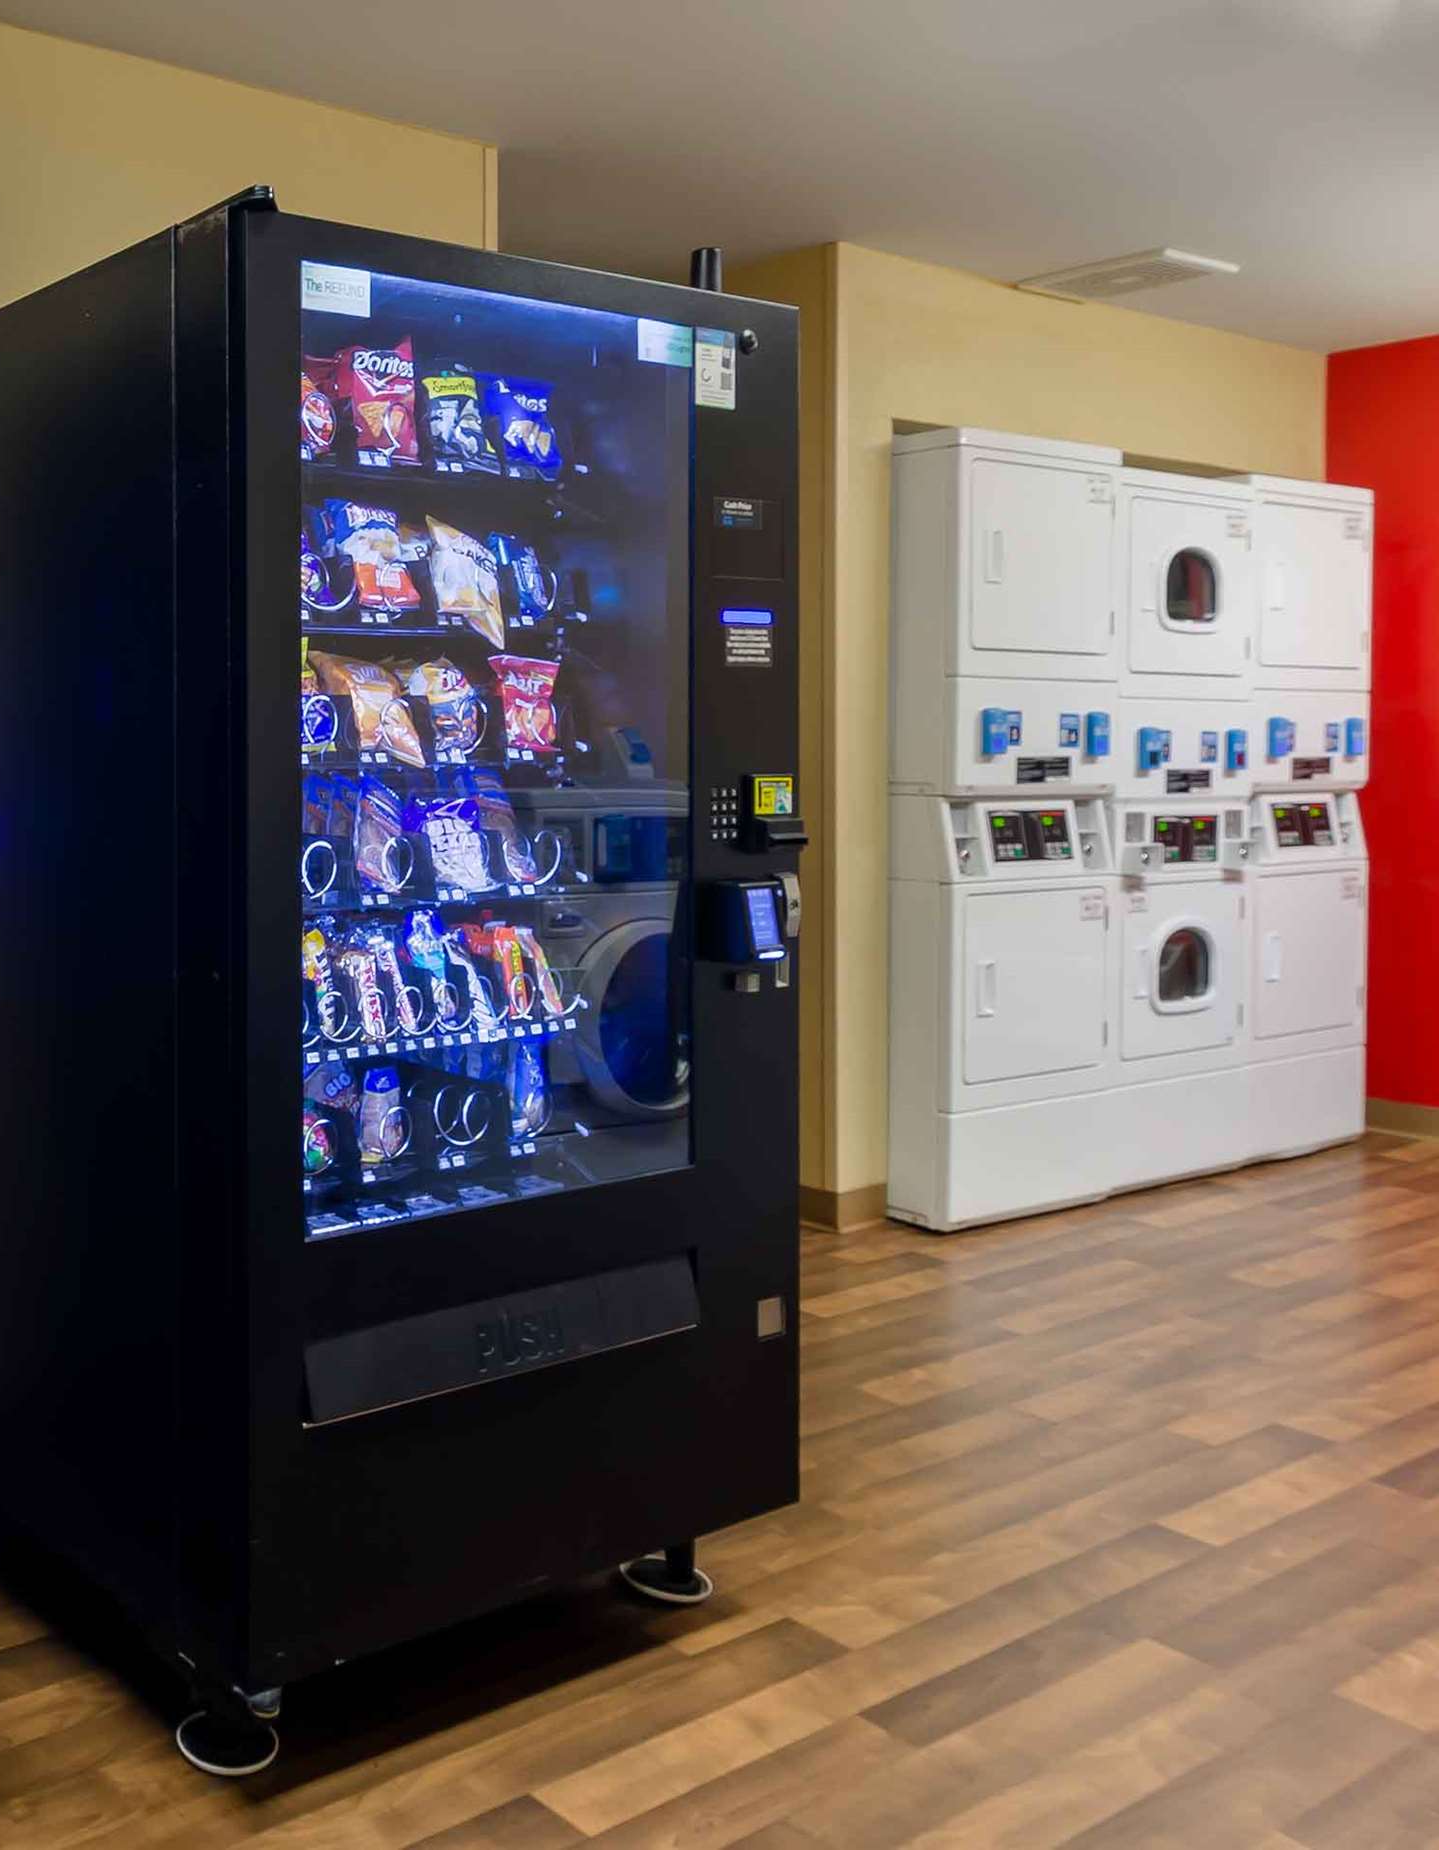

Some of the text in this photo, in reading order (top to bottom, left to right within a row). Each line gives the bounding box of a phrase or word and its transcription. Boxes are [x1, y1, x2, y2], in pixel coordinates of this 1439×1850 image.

[304, 277, 323, 293] The
[352, 350, 415, 379] Doritos
[477, 1312, 565, 1374] PUSH
